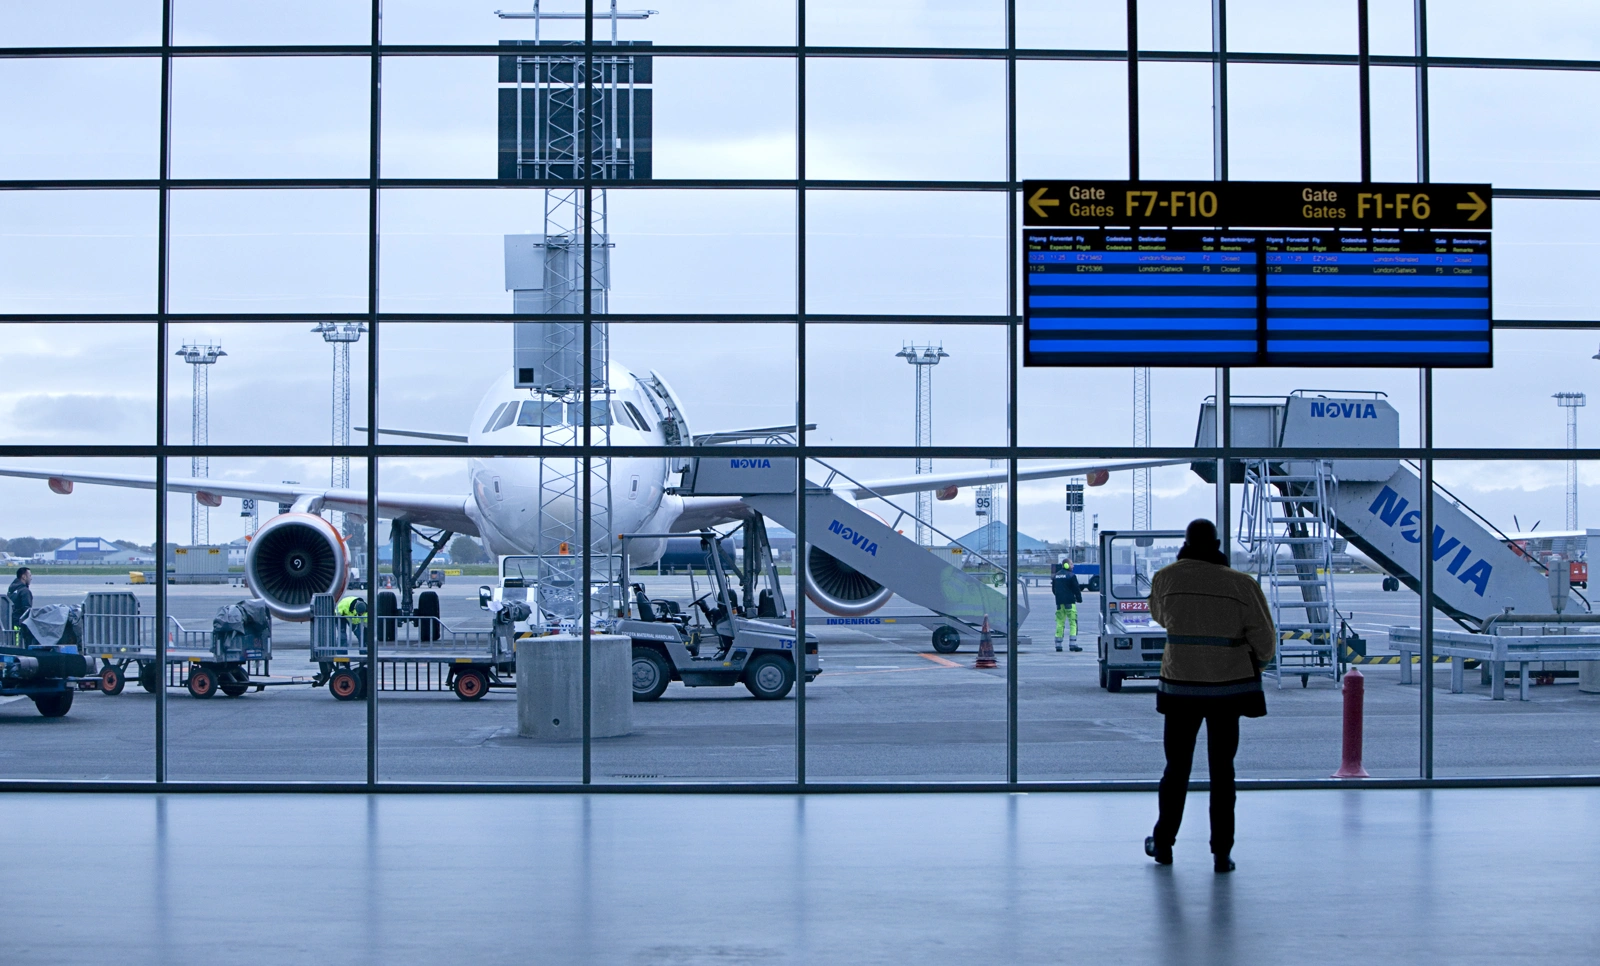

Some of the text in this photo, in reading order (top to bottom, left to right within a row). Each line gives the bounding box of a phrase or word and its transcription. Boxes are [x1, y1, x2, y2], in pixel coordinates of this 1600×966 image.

[1069, 186, 1105, 200] Gate
[1302, 188, 1337, 202] Gate
[1069, 203, 1114, 217] Gates
[1126, 191, 1218, 217] F7-F10
[1357, 193, 1431, 219] F1-F6
[1302, 204, 1346, 219] Gates
[1310, 402, 1377, 419] NOVIA
[730, 458, 771, 469] NOVIA
[242, 498, 254, 510] 93
[976, 497, 990, 508] 95
[828, 519, 878, 557] NOVIA
[1368, 485, 1493, 597] NOVIA
